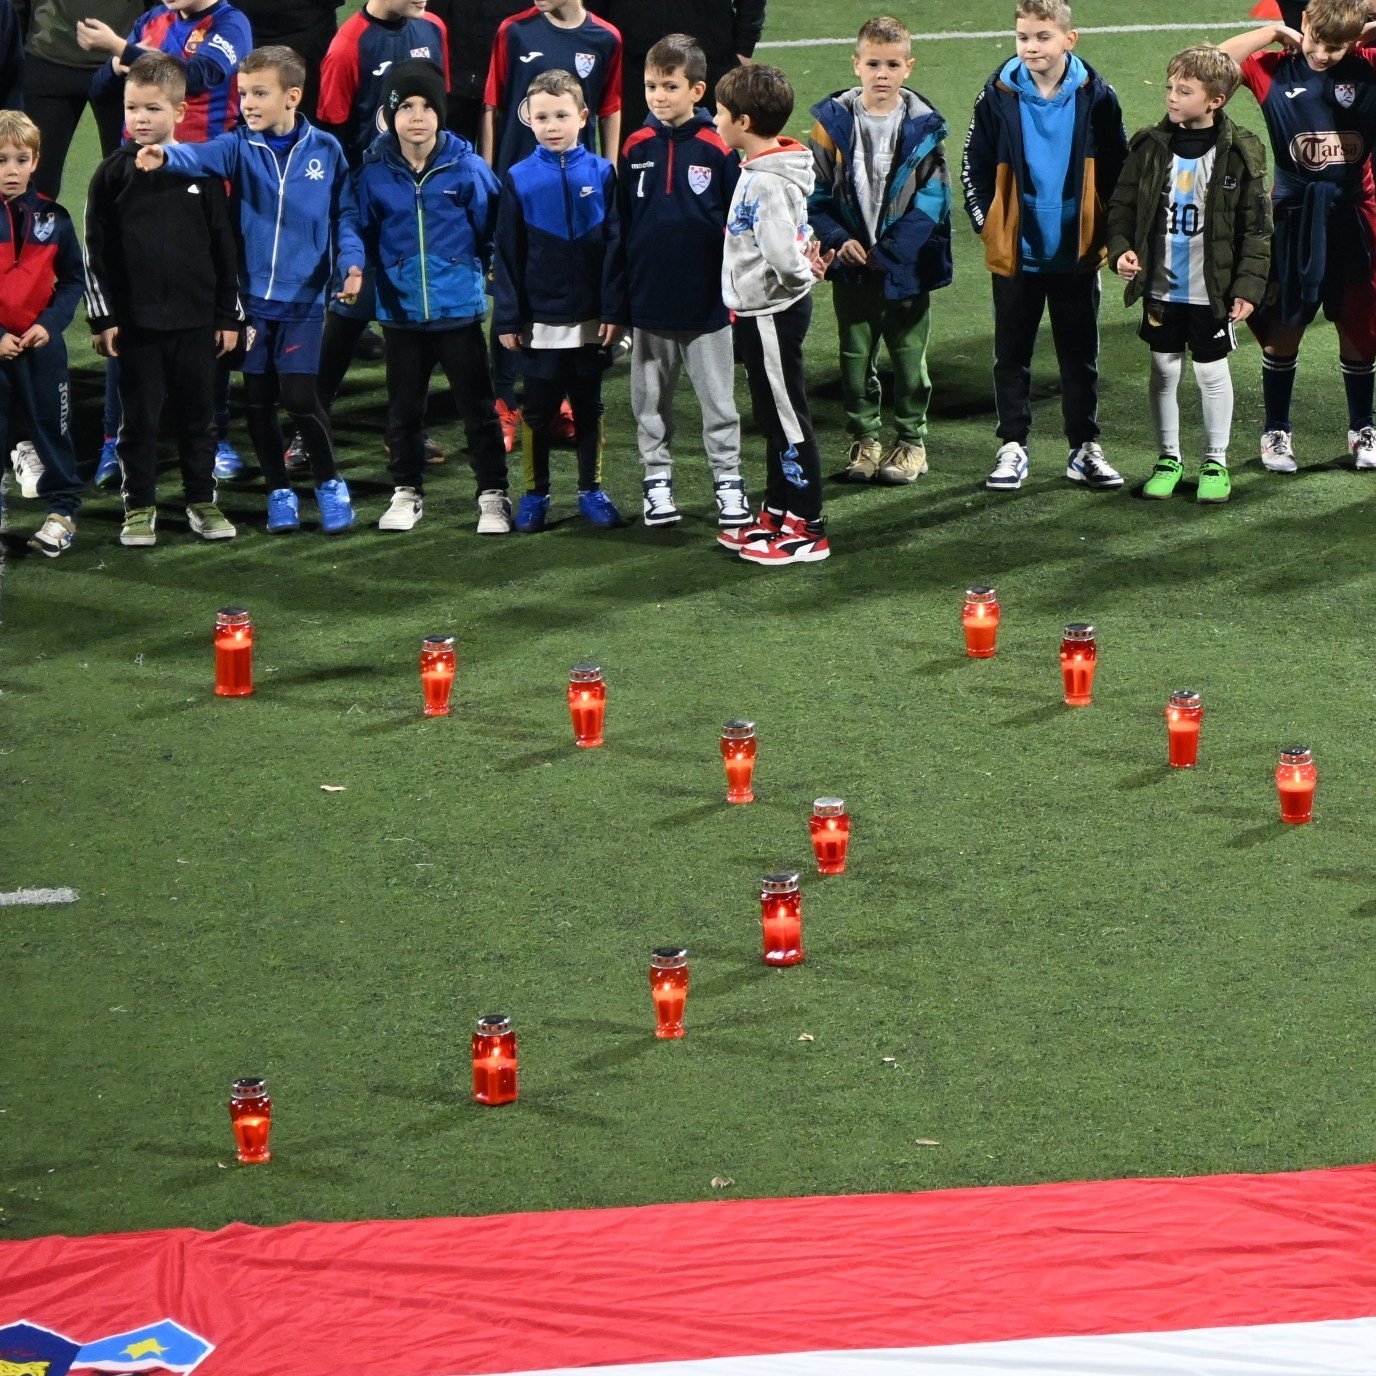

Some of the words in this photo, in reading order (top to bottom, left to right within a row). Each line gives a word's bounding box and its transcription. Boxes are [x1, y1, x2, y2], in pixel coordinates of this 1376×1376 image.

[212, 33, 238, 65] beko
[1301, 137, 1359, 169] Tarsa
[637, 170, 646, 198] 1
[1168, 202, 1200, 236] 10
